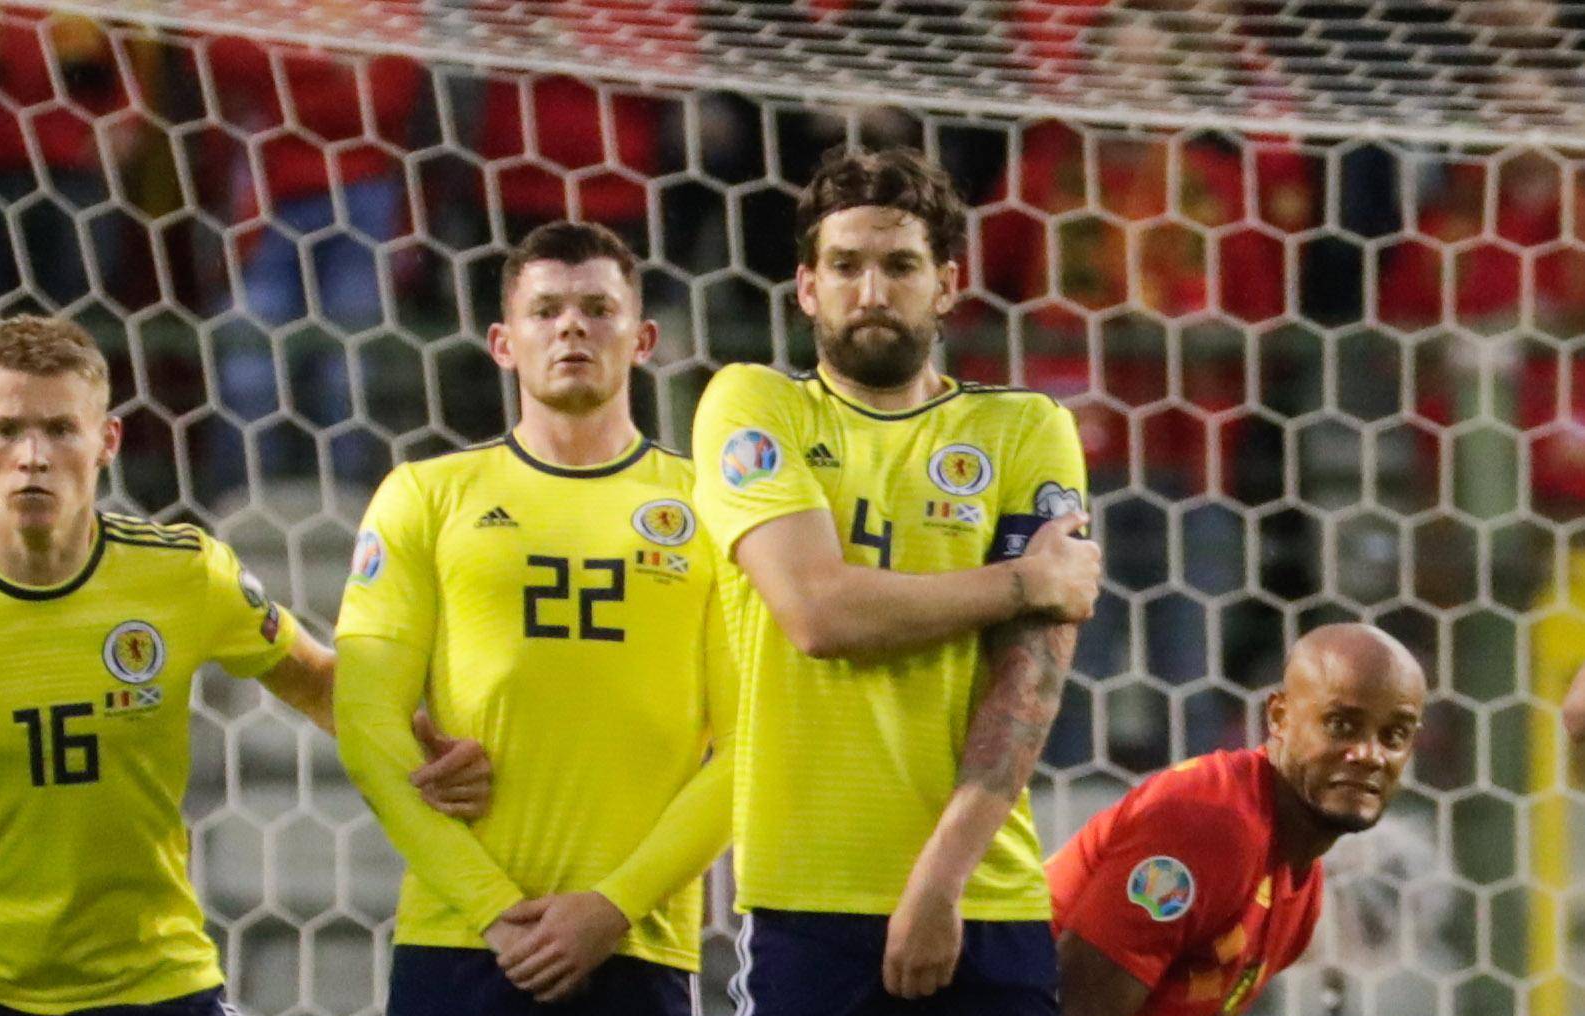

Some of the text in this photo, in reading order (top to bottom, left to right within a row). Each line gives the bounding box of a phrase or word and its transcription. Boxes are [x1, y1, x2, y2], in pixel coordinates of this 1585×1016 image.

[850, 497, 892, 569] 4
[523, 555, 625, 642] 22
[12, 702, 101, 787] 16
